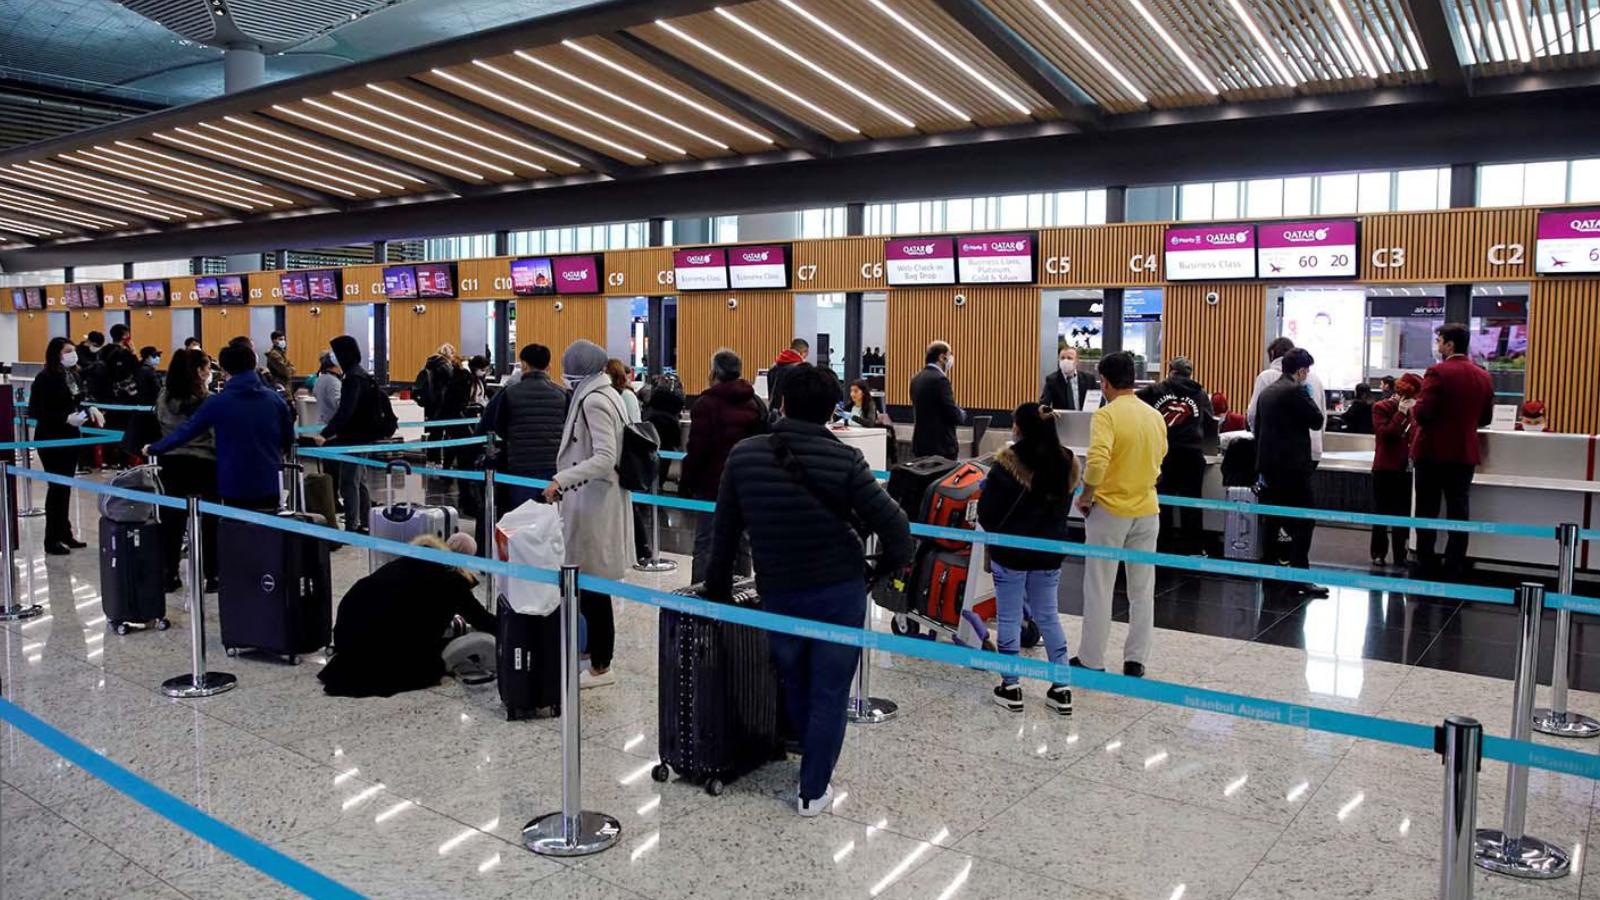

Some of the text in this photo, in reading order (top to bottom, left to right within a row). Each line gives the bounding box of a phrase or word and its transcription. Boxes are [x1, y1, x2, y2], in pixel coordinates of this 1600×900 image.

[1206, 233, 1235, 243] QATAR
[1283, 230, 1315, 241] QATAR
[903, 246, 925, 254] QATAR
[991, 242, 1015, 251] QATAR
[1298, 255, 1318, 268] 60
[1330, 254, 1349, 267] 20
[1371, 247, 1405, 268] C3
[1487, 243, 1525, 266] C2
[861, 262, 883, 279] C6
[1044, 256, 1071, 274] C5
[1129, 254, 1157, 273] C4
[1179, 260, 1242, 270] Business Class
[608, 272, 624, 286] C9
[657, 270, 674, 285] C8
[797, 265, 817, 281] C7
[345, 283, 360, 295] C13
[461, 278, 478, 291] C11
[494, 277, 512, 290] C10
[971, 657, 1049, 679] Istanbul Airport
[1184, 694, 1281, 721] Istanbul Airport
